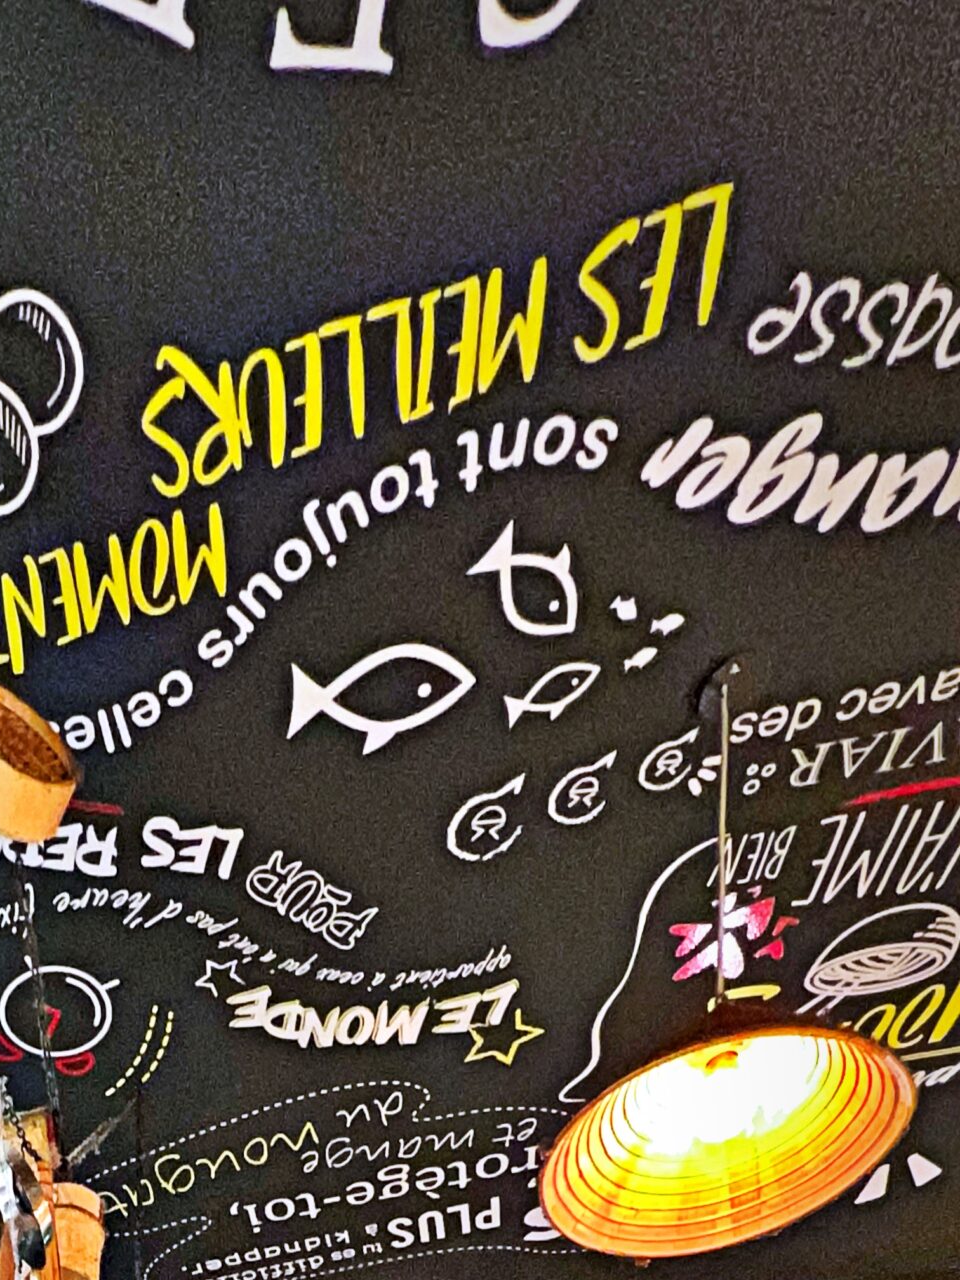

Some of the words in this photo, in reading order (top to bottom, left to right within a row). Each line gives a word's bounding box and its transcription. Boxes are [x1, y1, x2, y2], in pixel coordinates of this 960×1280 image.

[572, 181, 734, 363] LES
[141, 256, 548, 498] MEILLEURS
[456, 414, 619, 492] sont
[197, 448, 440, 668] toujours
[49, 670, 193, 754] celle
[837, 666, 960, 722] avec
[730, 698, 822, 744] des
[790, 720, 960, 788] VIAR
[141, 816, 244, 880] LES
[707, 825, 797, 888] BIEN
[53, 886, 183, 929] d'heure
[186, 910, 238, 935] pas
[246, 851, 378, 950] POUR
[270, 954, 318, 976] qui
[316, 966, 365, 985] ceux
[367, 970, 385, 992] à
[390, 944, 512, 991] appartient
[226, 985, 430, 1048] MONDE
[432, 979, 520, 1034] LE
[337, 1091, 403, 1128] du
[492, 1117, 538, 1145] et
[301, 1128, 478, 1174] mange
[229, 1145, 540, 1233] rotège-toi,
[387, 1197, 501, 1247] PLUS
[181, 1229, 351, 1276] kidnapper.
[331, 1248, 356, 1262] es
[362, 1242, 383, 1255] tu
